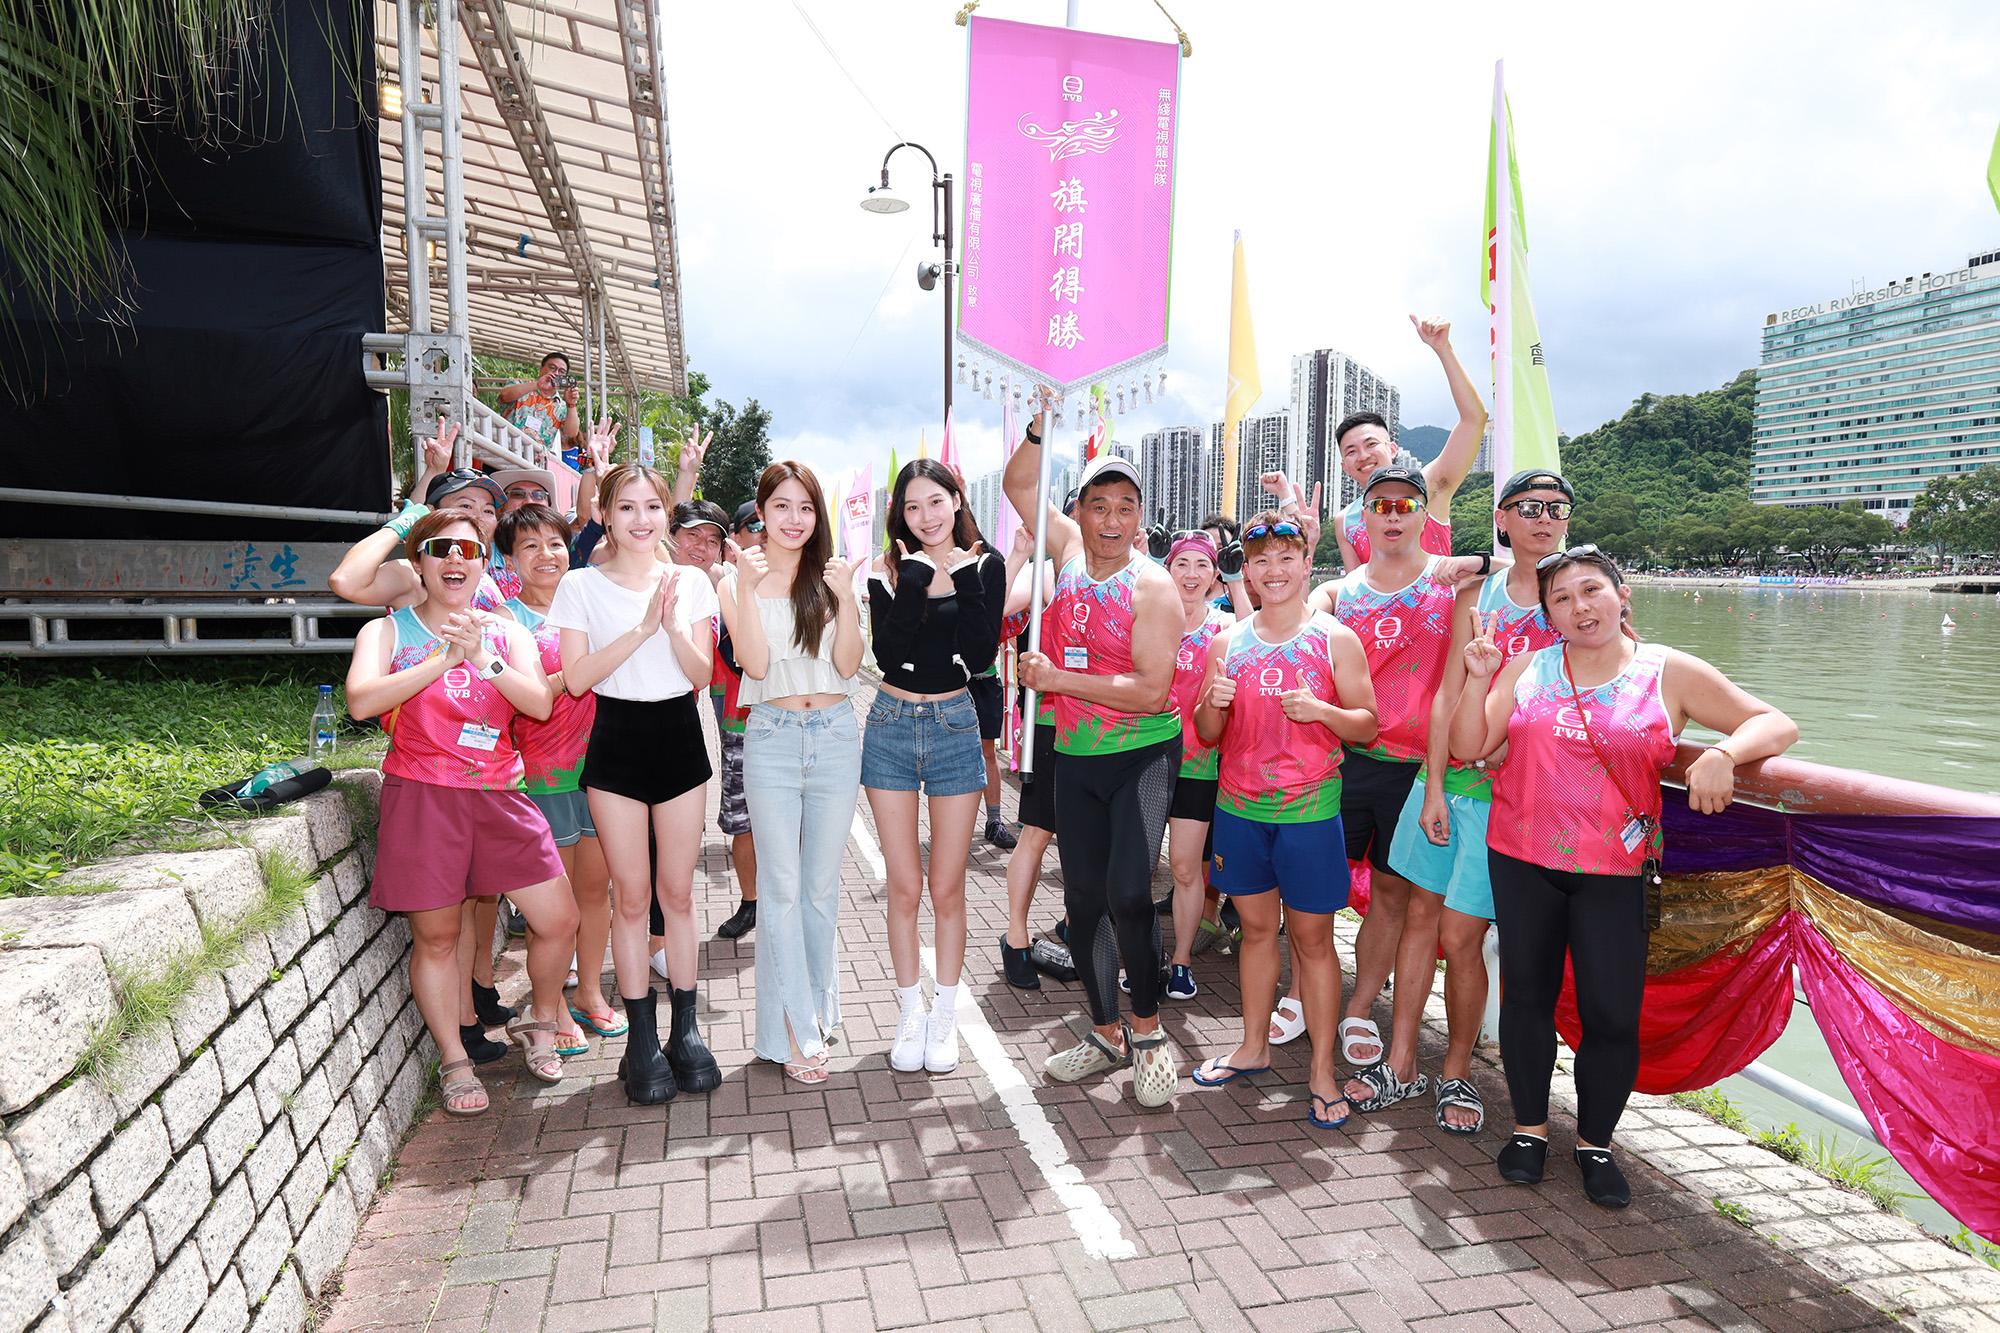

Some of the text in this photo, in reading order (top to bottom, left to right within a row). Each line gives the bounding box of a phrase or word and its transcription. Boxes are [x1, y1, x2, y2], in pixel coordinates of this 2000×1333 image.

[1062, 93, 1083, 103] TVB
[967, 161, 984, 281] 電視廣播有限公司
[1046, 175, 1089, 351] 旗開得勝
[1781, 268, 1979, 322] REGAL RIVERSIDE HOTEL
[444, 688, 471, 698] TVB
[1259, 687, 1282, 696] TVB
[1552, 725, 1588, 741] TVB
